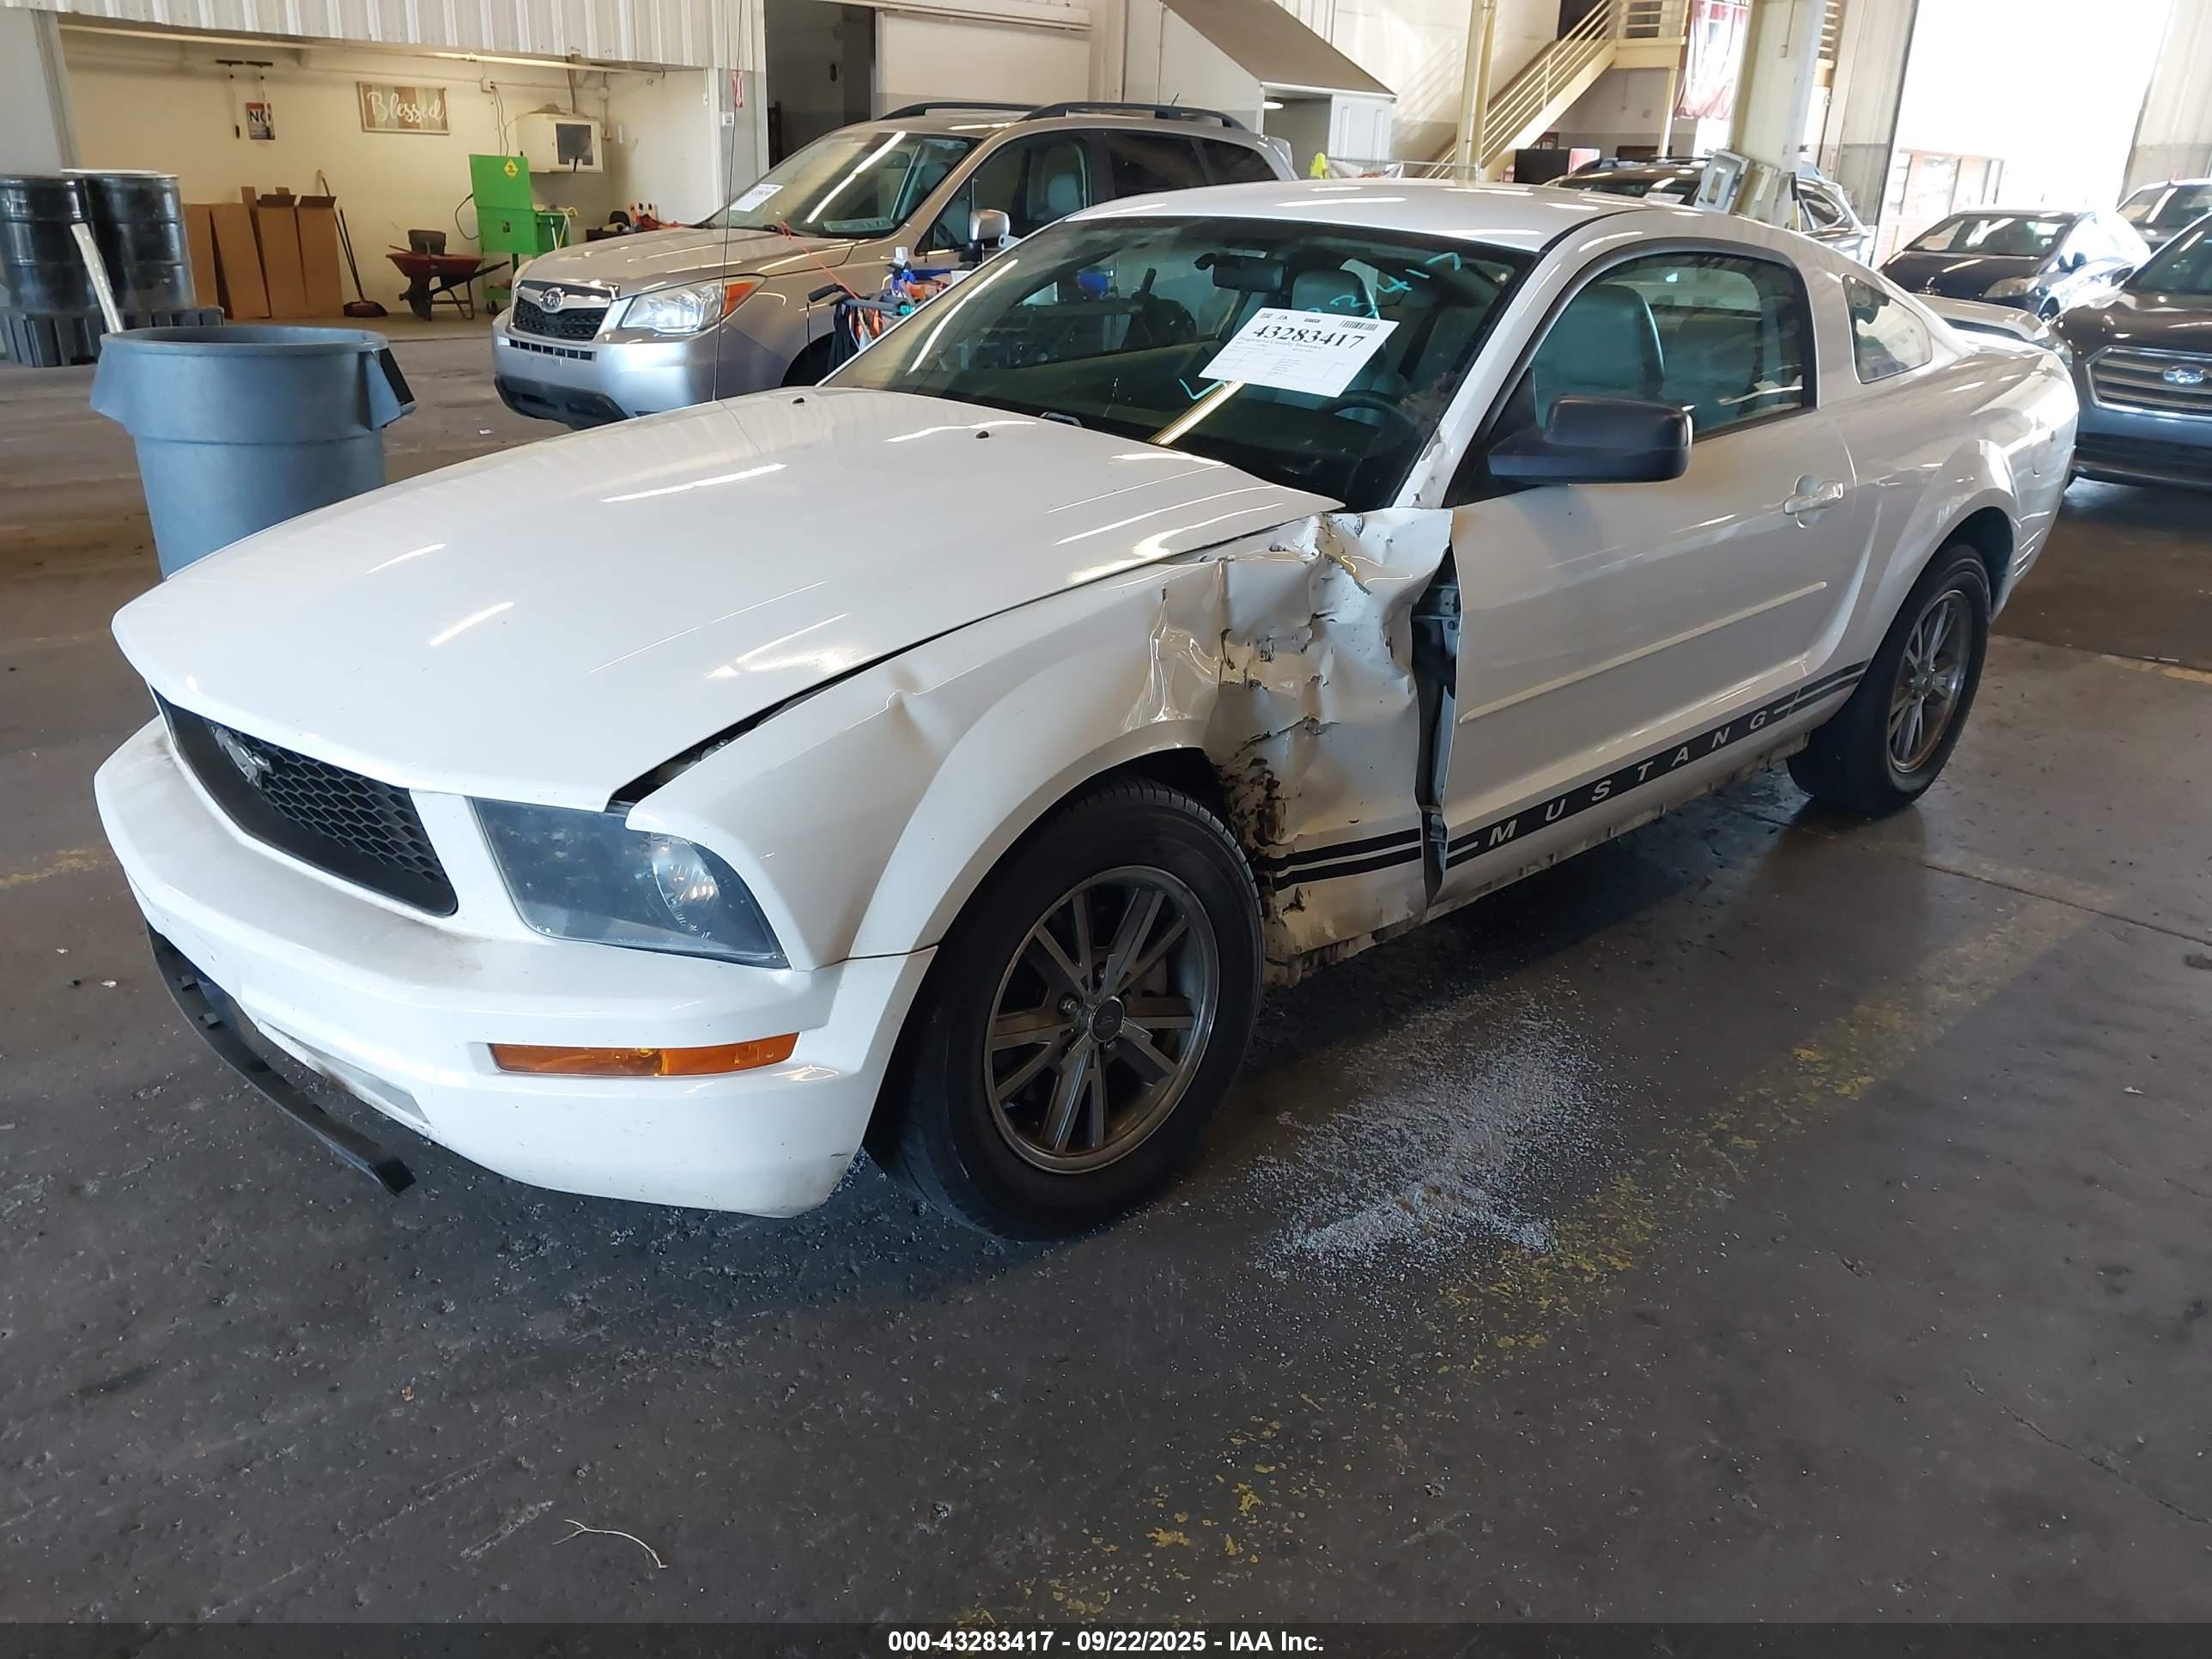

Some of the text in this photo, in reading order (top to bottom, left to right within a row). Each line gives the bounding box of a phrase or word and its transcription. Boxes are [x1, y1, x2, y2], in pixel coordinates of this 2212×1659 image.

[367, 91, 445, 123] Blessed
[1253, 325, 1366, 349] 43283417
[1488, 709, 1767, 848] MUSTANG
